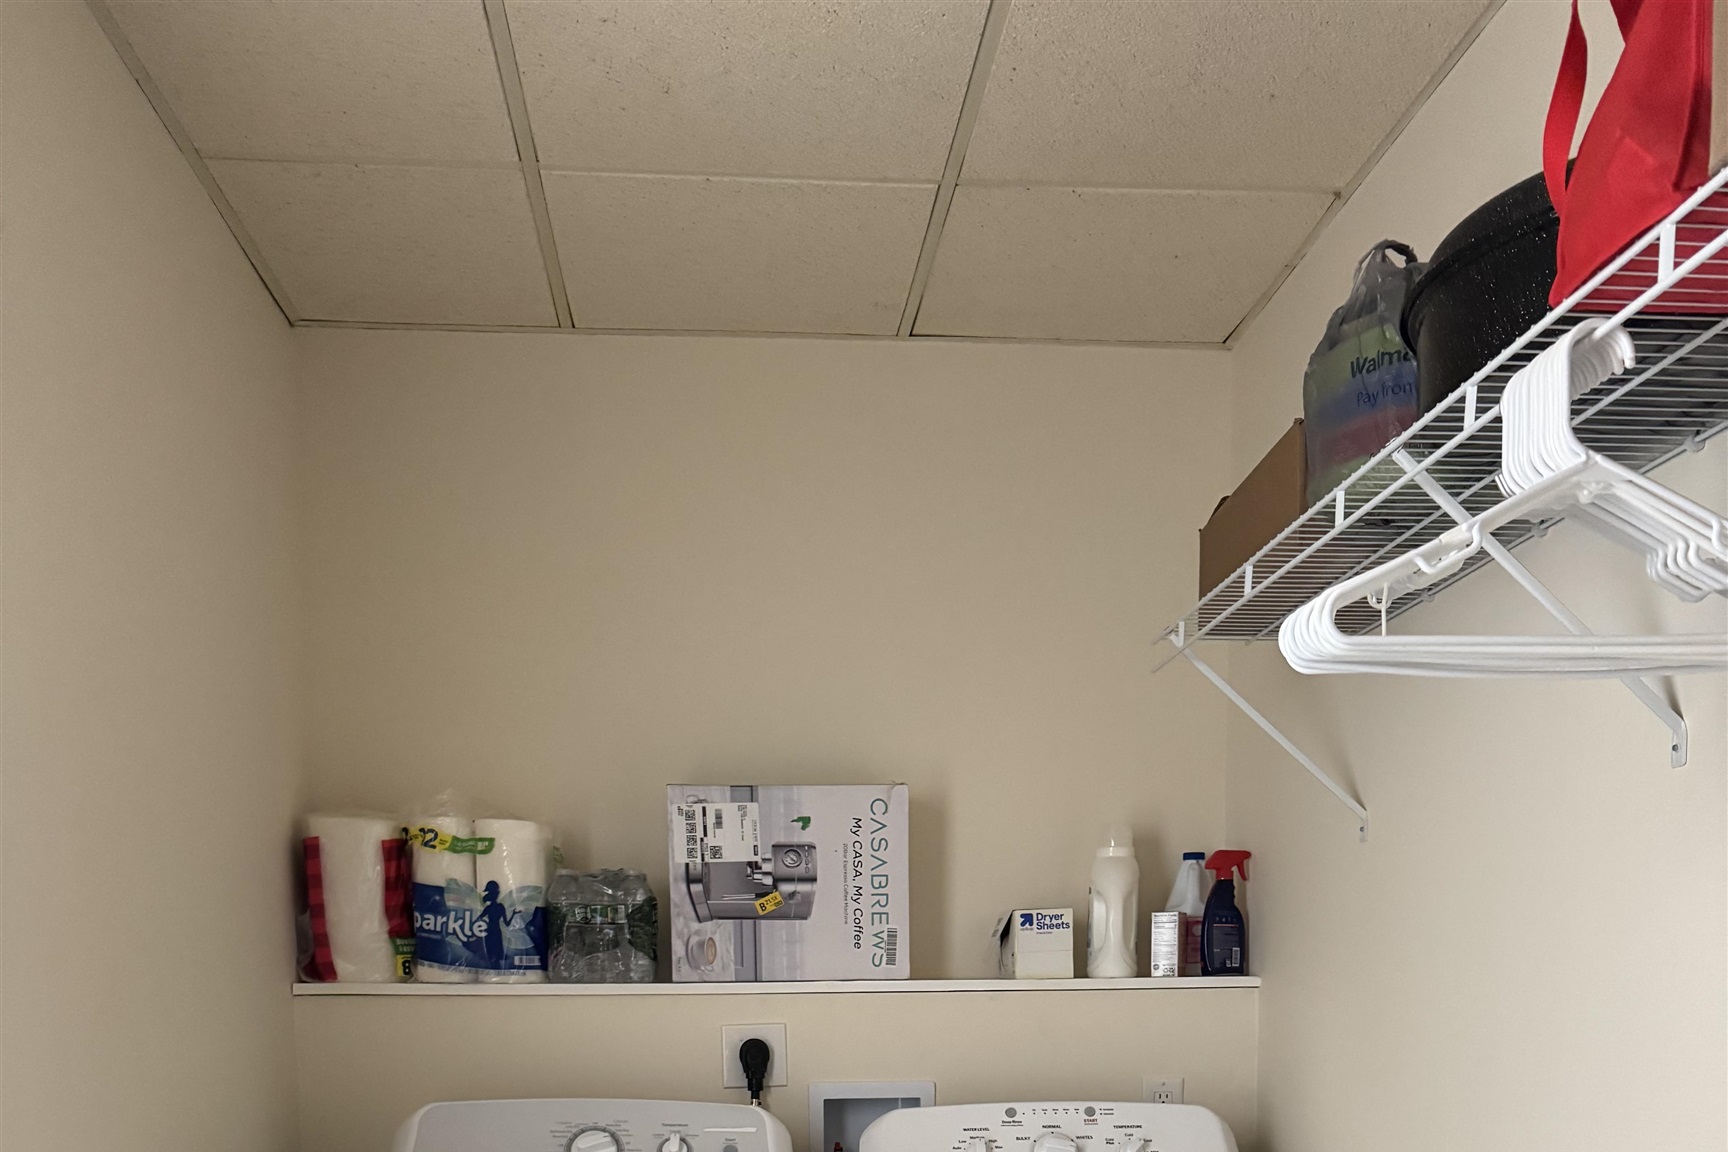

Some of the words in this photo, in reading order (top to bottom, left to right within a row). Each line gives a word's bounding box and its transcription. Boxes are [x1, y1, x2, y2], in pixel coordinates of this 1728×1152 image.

[1357, 390, 1379, 408] Pay
[850, 817, 863, 838] My
[851, 840, 863, 882] CASA,
[869, 797, 889, 968] CASABREWS
[850, 884, 863, 905] My
[758, 902, 768, 912] B
[1036, 912, 1065, 922] Dryer
[414, 910, 489, 942] parkle
[852, 907, 864, 950] Coffee
[1036, 921, 1071, 931] Sheets
